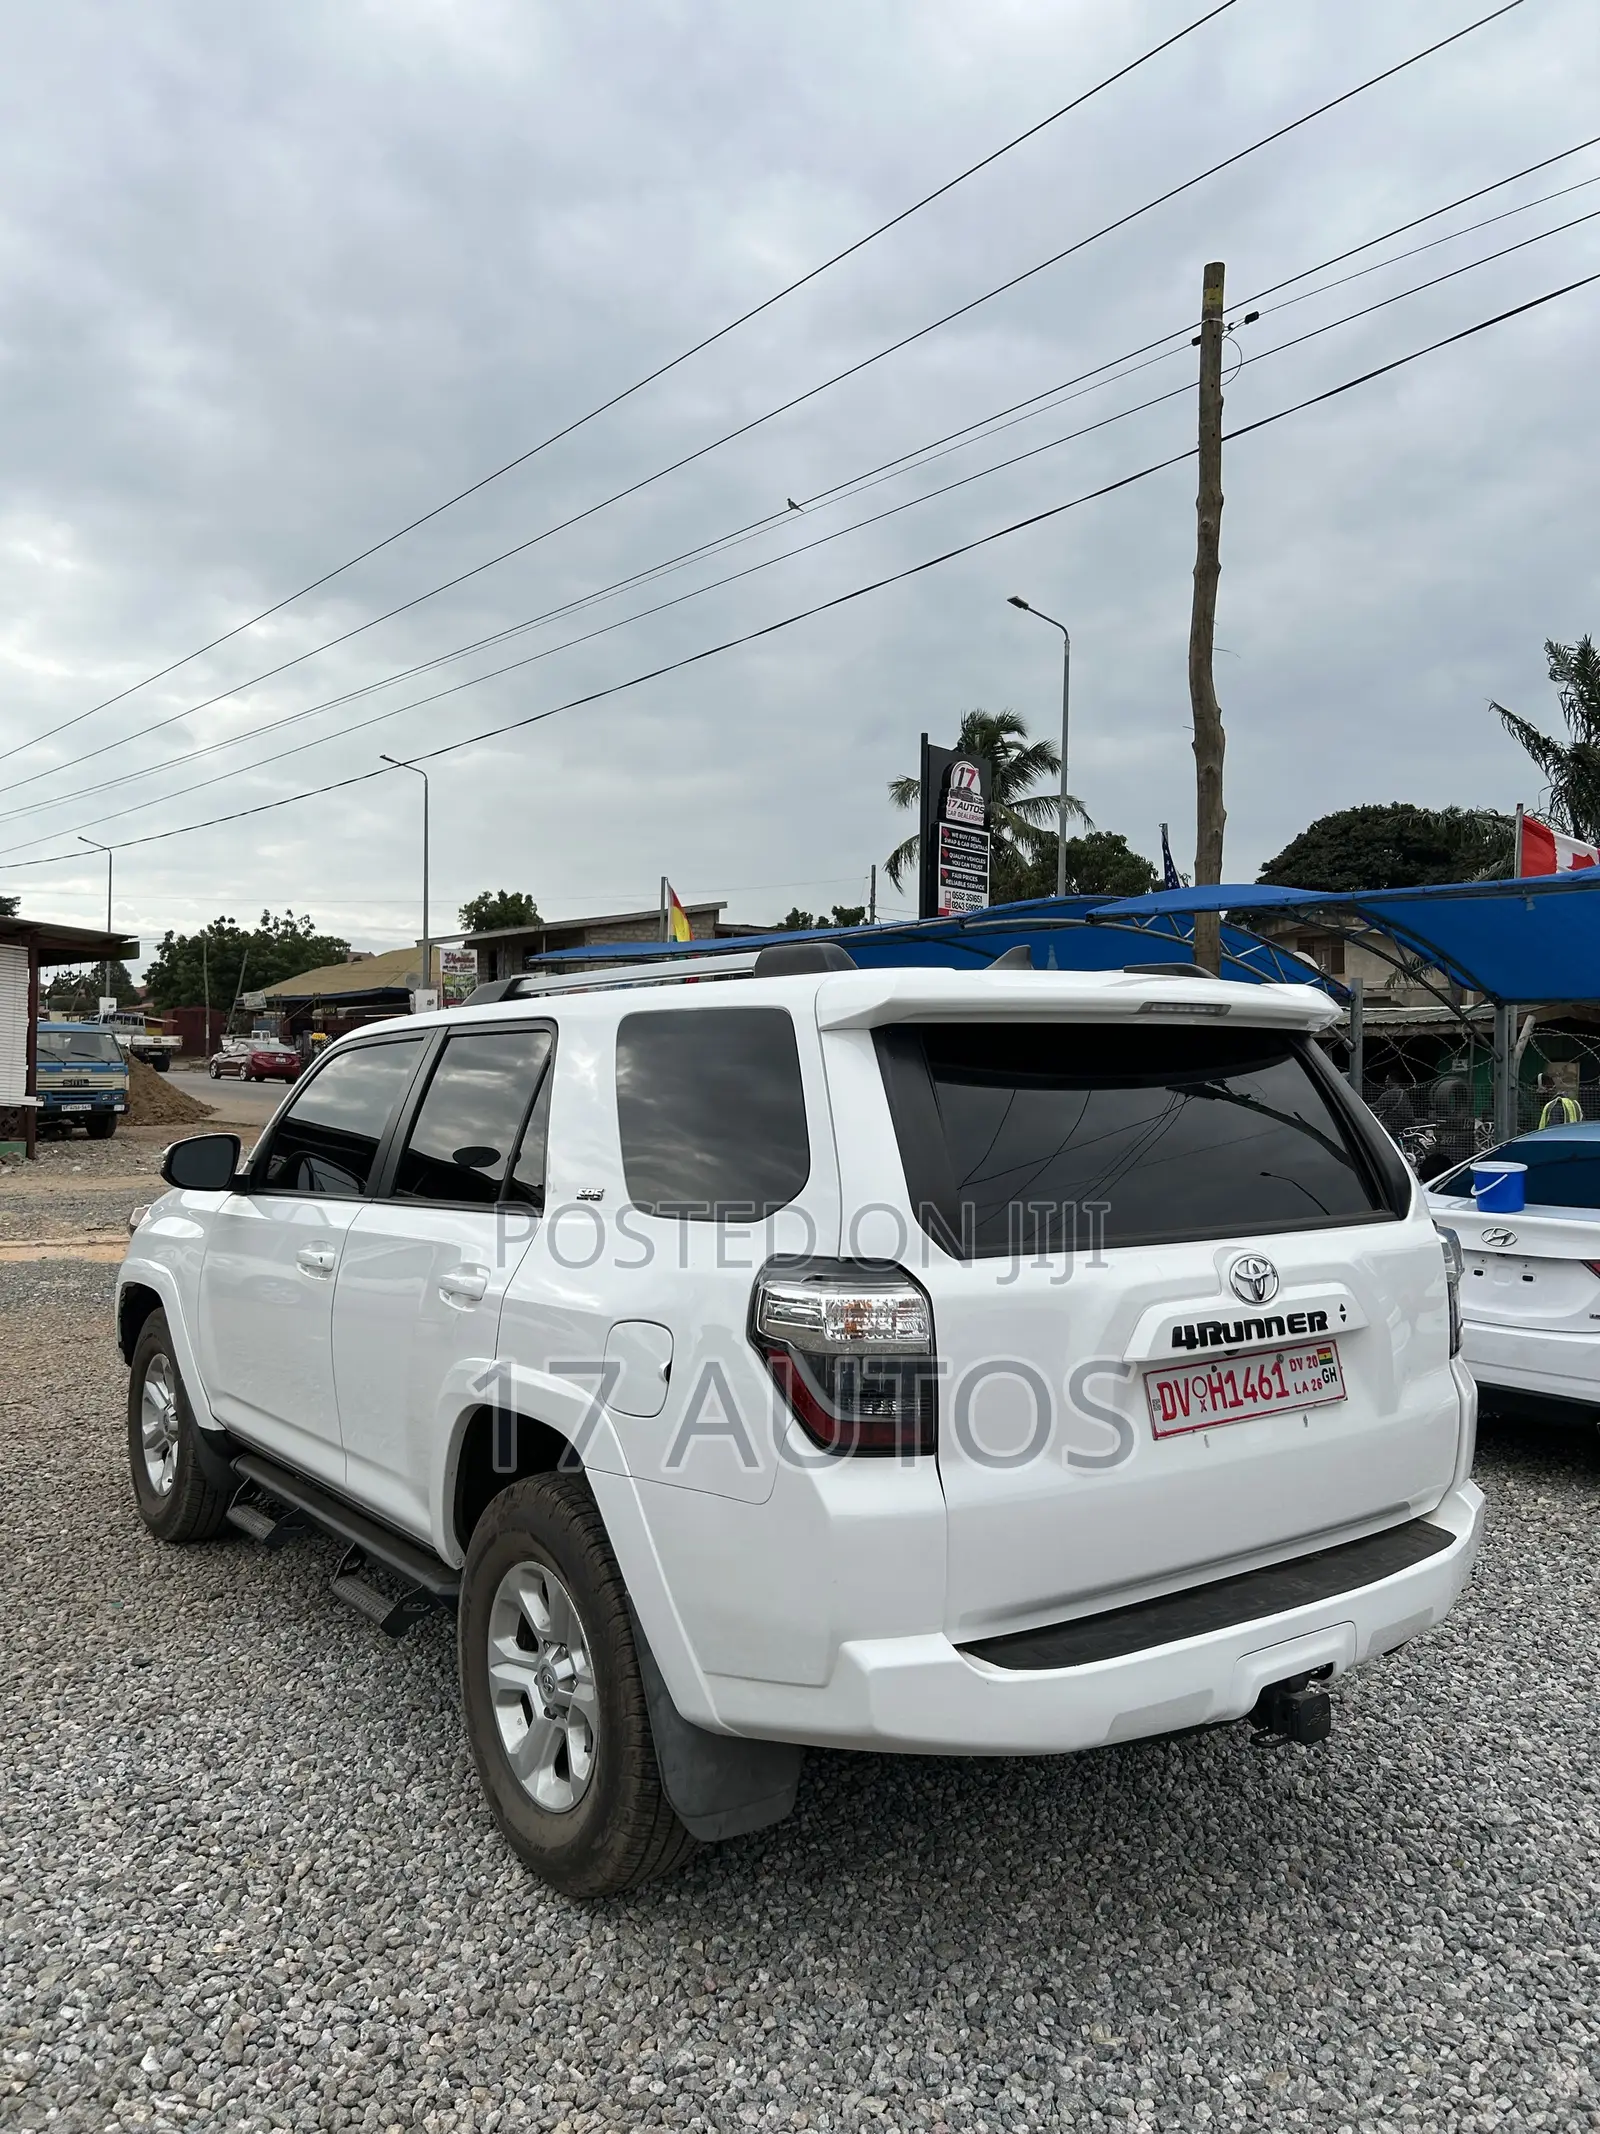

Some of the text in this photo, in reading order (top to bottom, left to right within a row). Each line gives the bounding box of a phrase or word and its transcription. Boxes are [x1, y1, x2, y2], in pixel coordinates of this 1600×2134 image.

[957, 767, 977, 788] 17
[948, 800, 984, 814] 17 AUTOS
[970, 843, 988, 851] RENTALS
[946, 879, 985, 891] RELIABLE SERVICE
[952, 891, 965, 900] 0552
[1289, 1355, 1319, 1373] DV 20
[1321, 1367, 1339, 1384] GH
[1294, 1381, 1310, 1395] LA
[1157, 1377, 1191, 1422] DV
